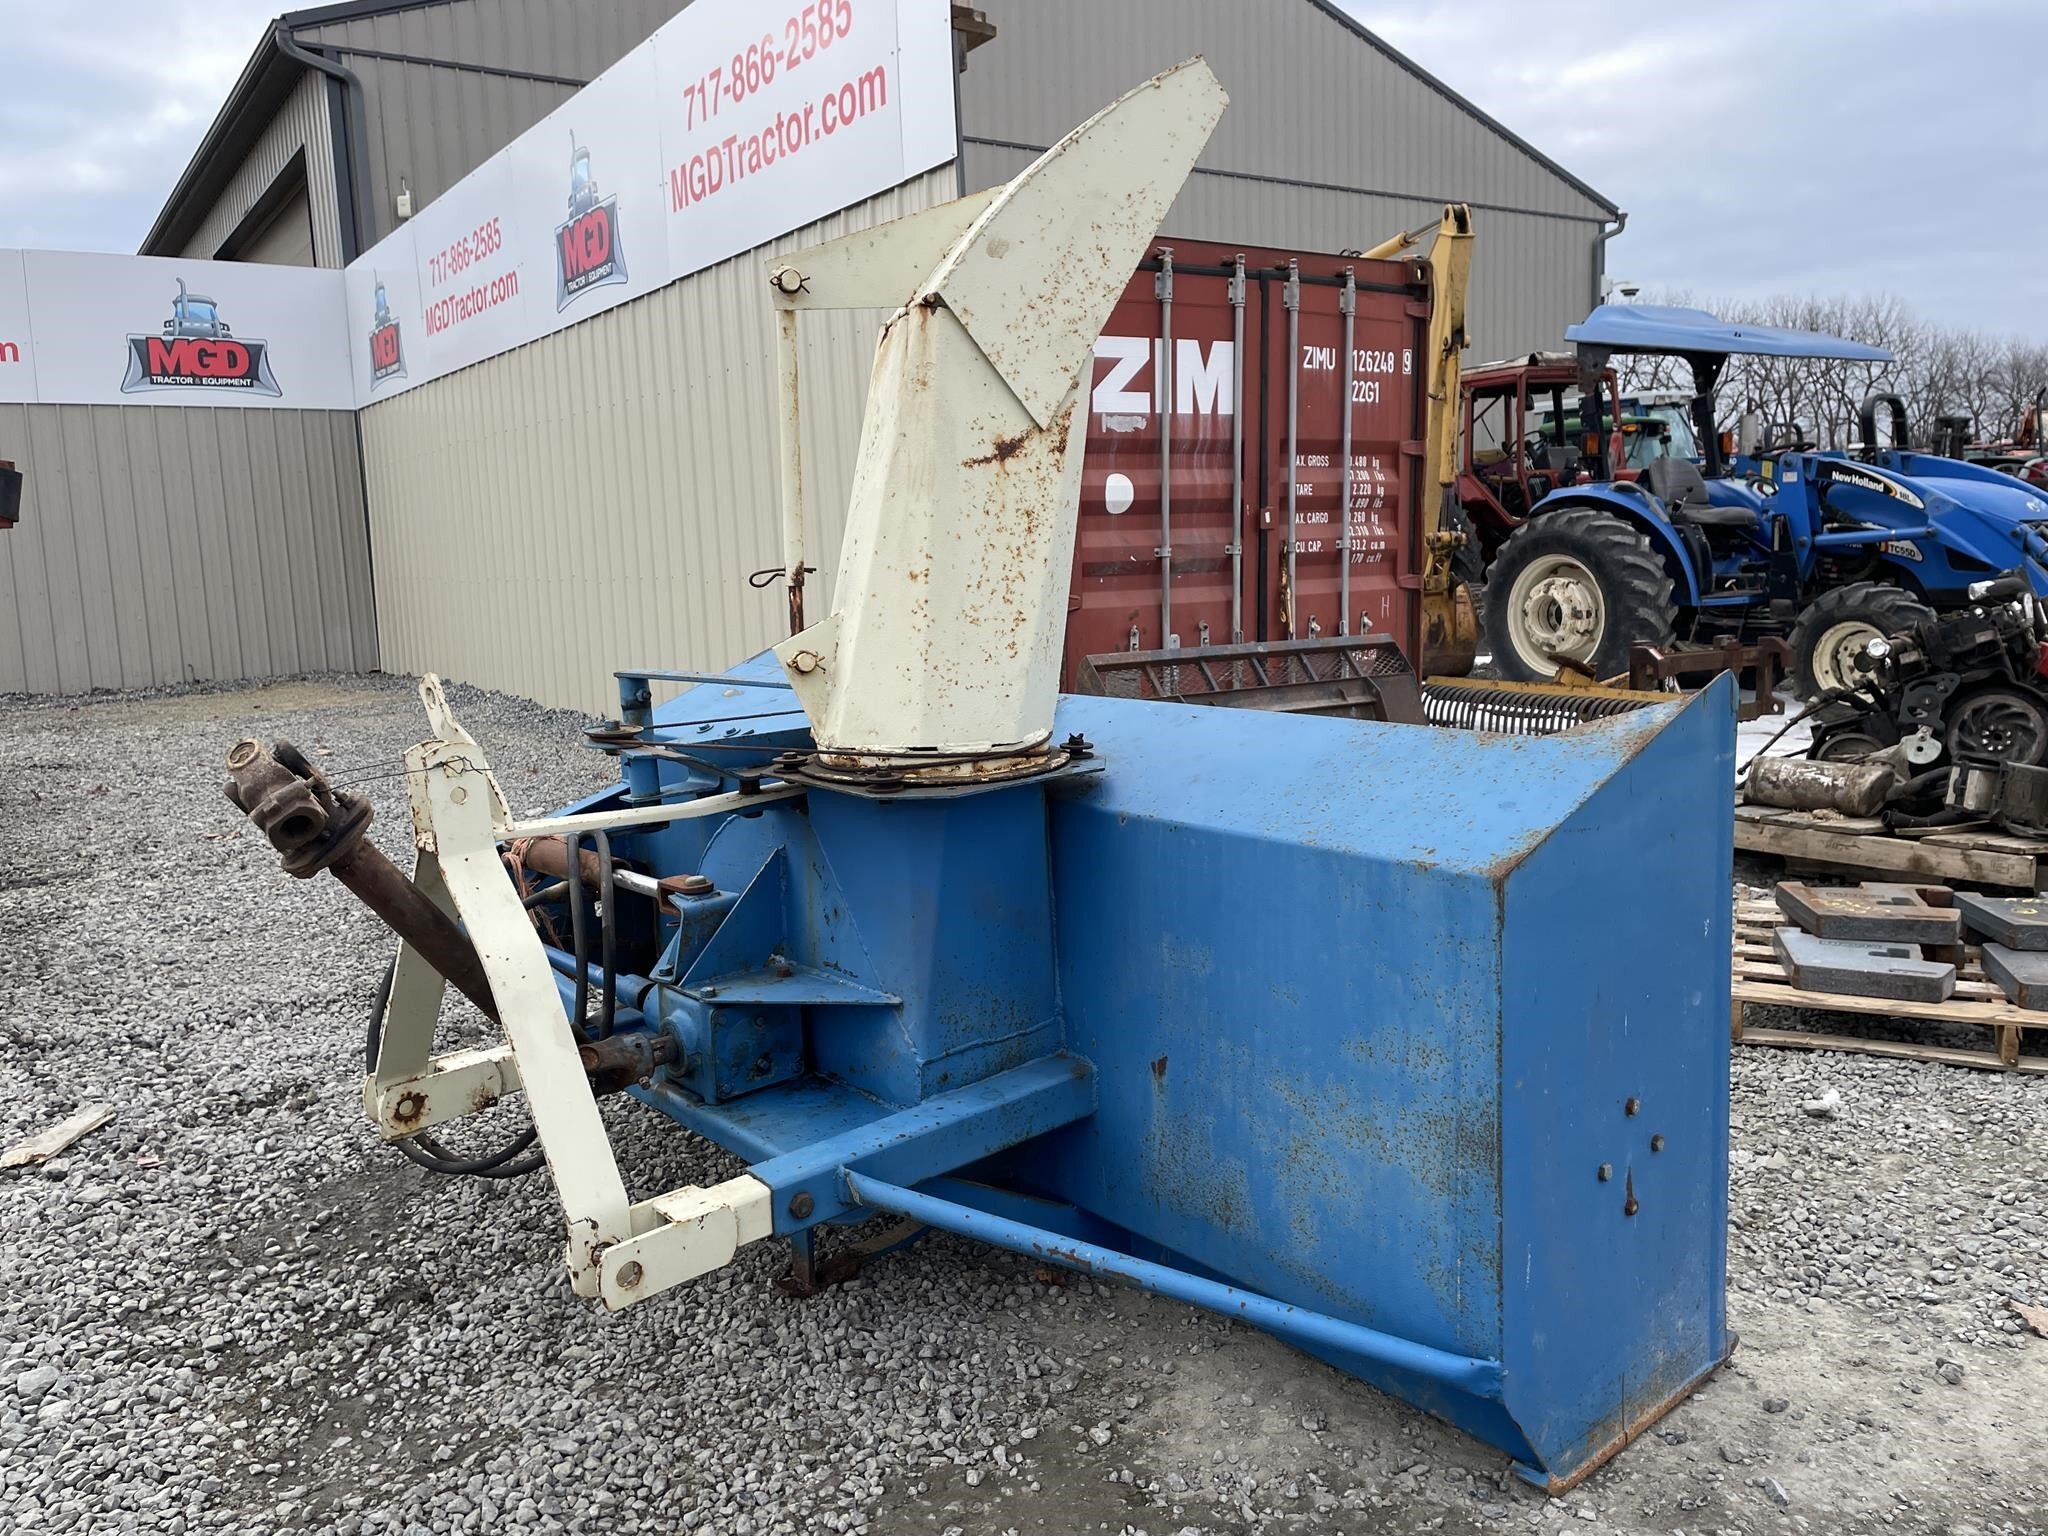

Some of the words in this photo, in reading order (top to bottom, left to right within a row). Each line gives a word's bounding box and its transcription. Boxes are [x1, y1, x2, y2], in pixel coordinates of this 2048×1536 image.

[684, 0, 852, 131] 717-866-2585
[670, 65, 886, 213] MGDTractor.com
[429, 217, 501, 288] 717-866-2585
[563, 206, 610, 280] MGD
[425, 270, 518, 337] MGDTractor.com
[146, 337, 250, 377] MGD
[1303, 346, 1336, 370] ZIMU
[1353, 350, 1394, 373] 126248
[152, 376, 193, 385] TRACTOR
[202, 377, 251, 387] EQUIPMENT
[1092, 336, 1234, 414] ZIM
[1352, 380, 1380, 403] 22G1
[1296, 455, 1306, 467] AX.
[1308, 455, 1330, 467] GROSS
[1372, 455, 1380, 470] kg
[1296, 484, 1313, 496] TARE
[1353, 483, 1371, 495] 2.220
[1377, 483, 1384, 498] kg
[1832, 470, 1851, 483] New
[1852, 474, 1884, 493] Holland
[1295, 513, 1305, 524] AX.
[1307, 512, 1329, 524] CARGO
[1308, 541, 1324, 553] CAP.
[1352, 539, 1366, 551] 33.2
[1890, 543, 1916, 558] TC55D
